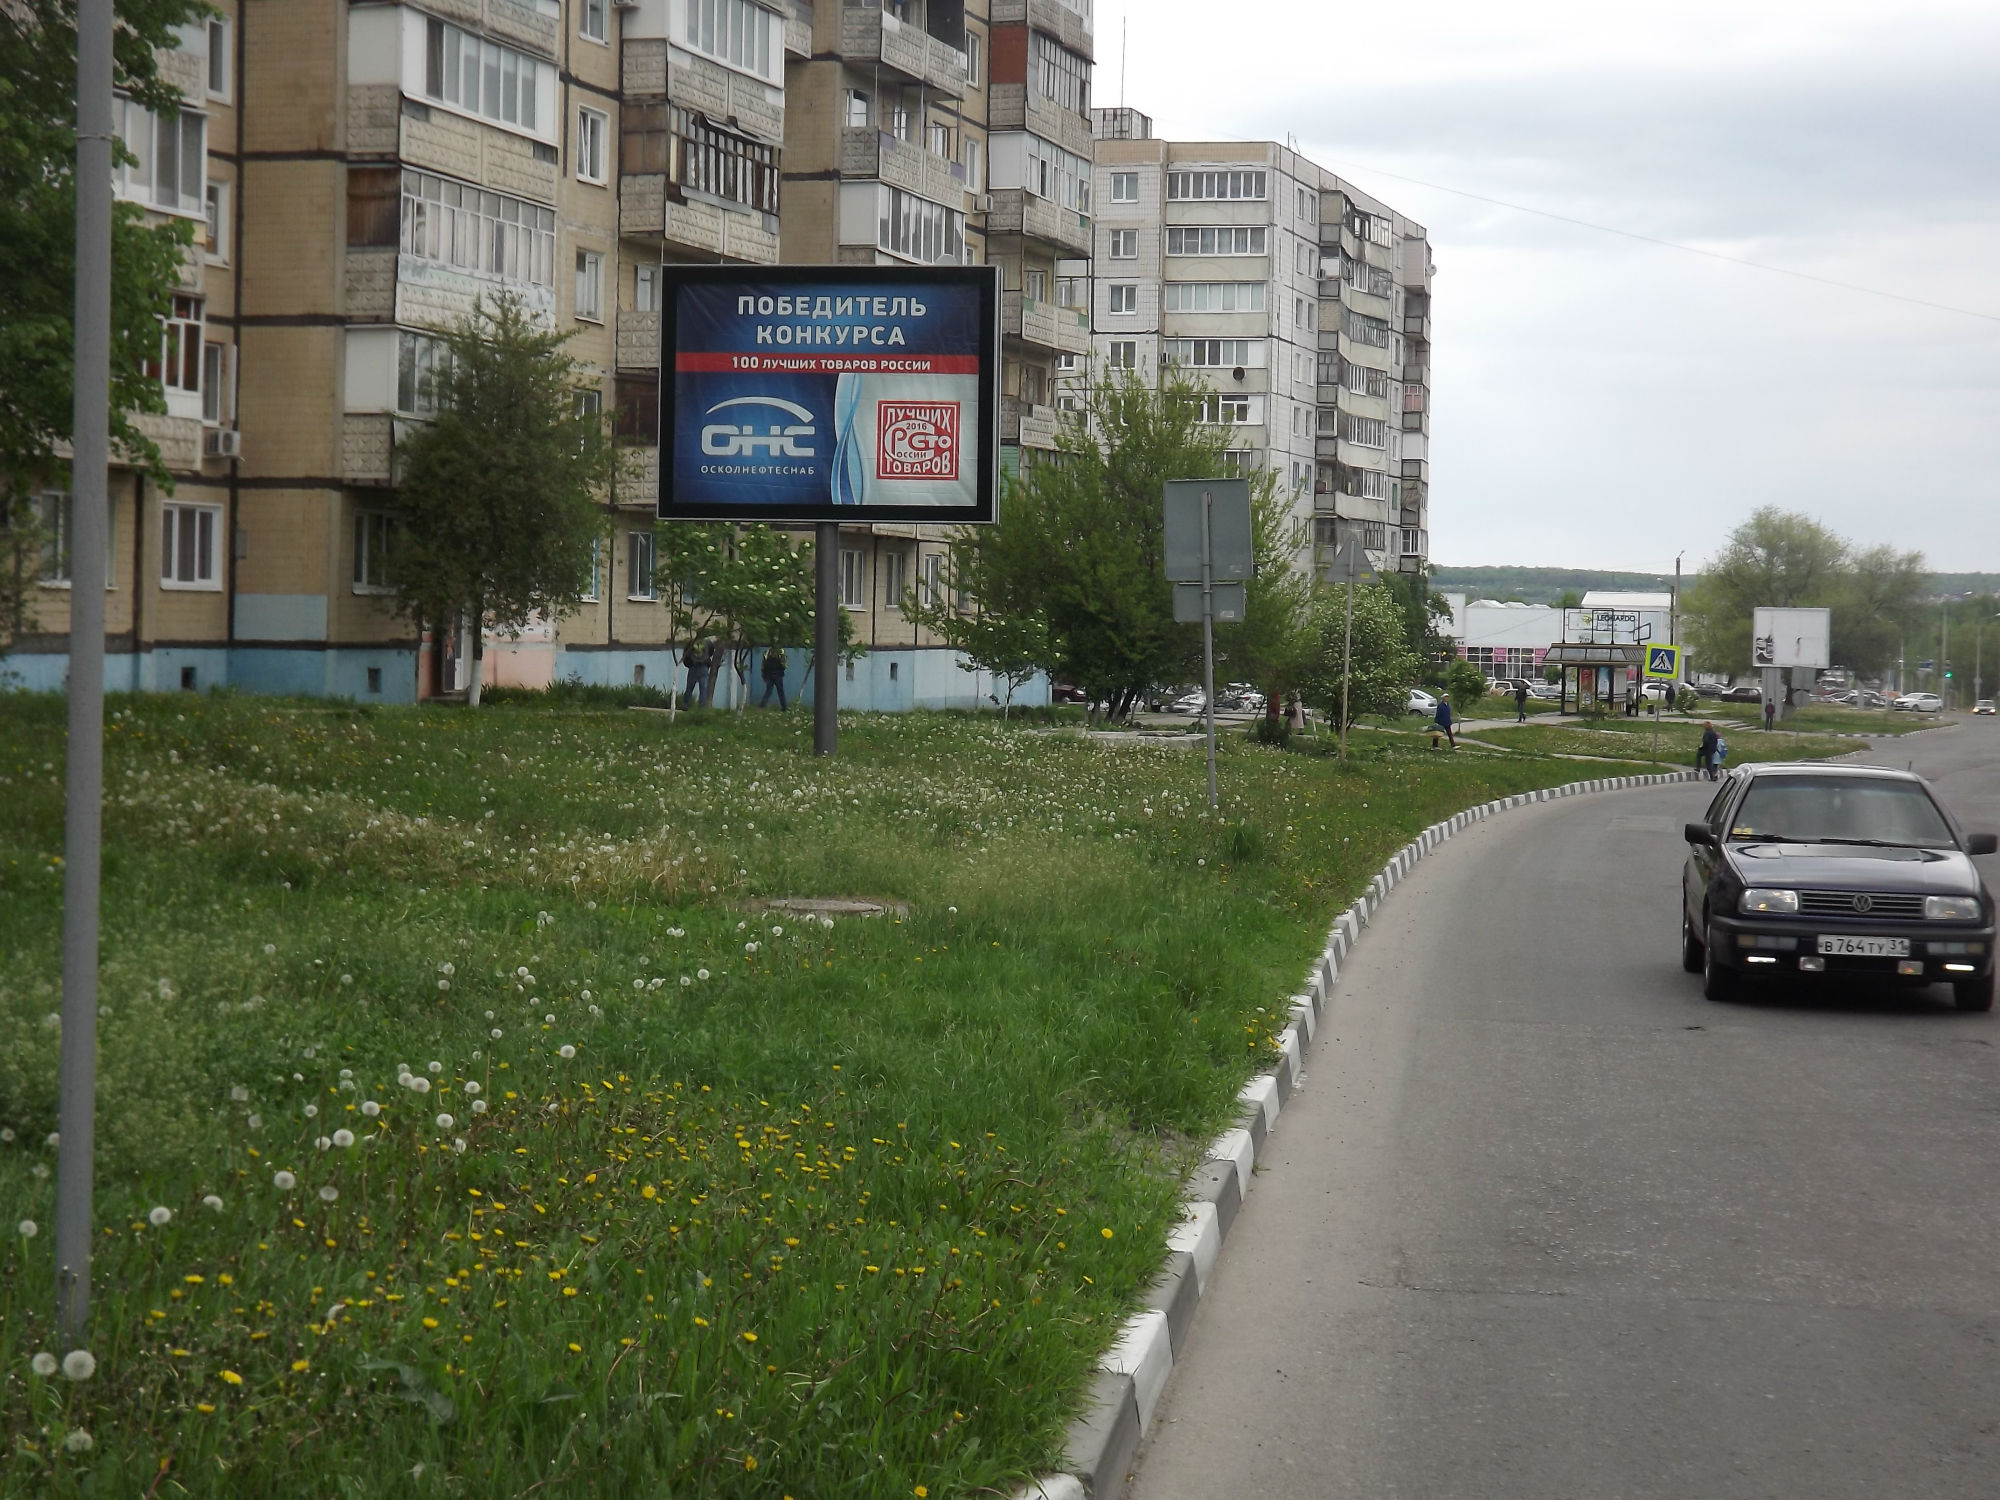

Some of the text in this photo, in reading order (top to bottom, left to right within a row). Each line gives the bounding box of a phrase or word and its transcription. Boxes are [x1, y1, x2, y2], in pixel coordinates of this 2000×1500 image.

[737, 296, 927, 320] ПОБЕДИТЕЛЬ
[756, 325, 906, 346] КОНКУРСА
[731, 356, 931, 371] 100 ЛУЧШИХ ТОВАРОВ РОССИИ
[885, 408, 952, 434] ЛУЧШИХ
[906, 422, 927, 431] 2016
[701, 424, 816, 457] ОНС
[700, 465, 815, 475] ОСКОЛНЕФТЕСНАБ
[885, 451, 951, 474] ТОВАРОВ
